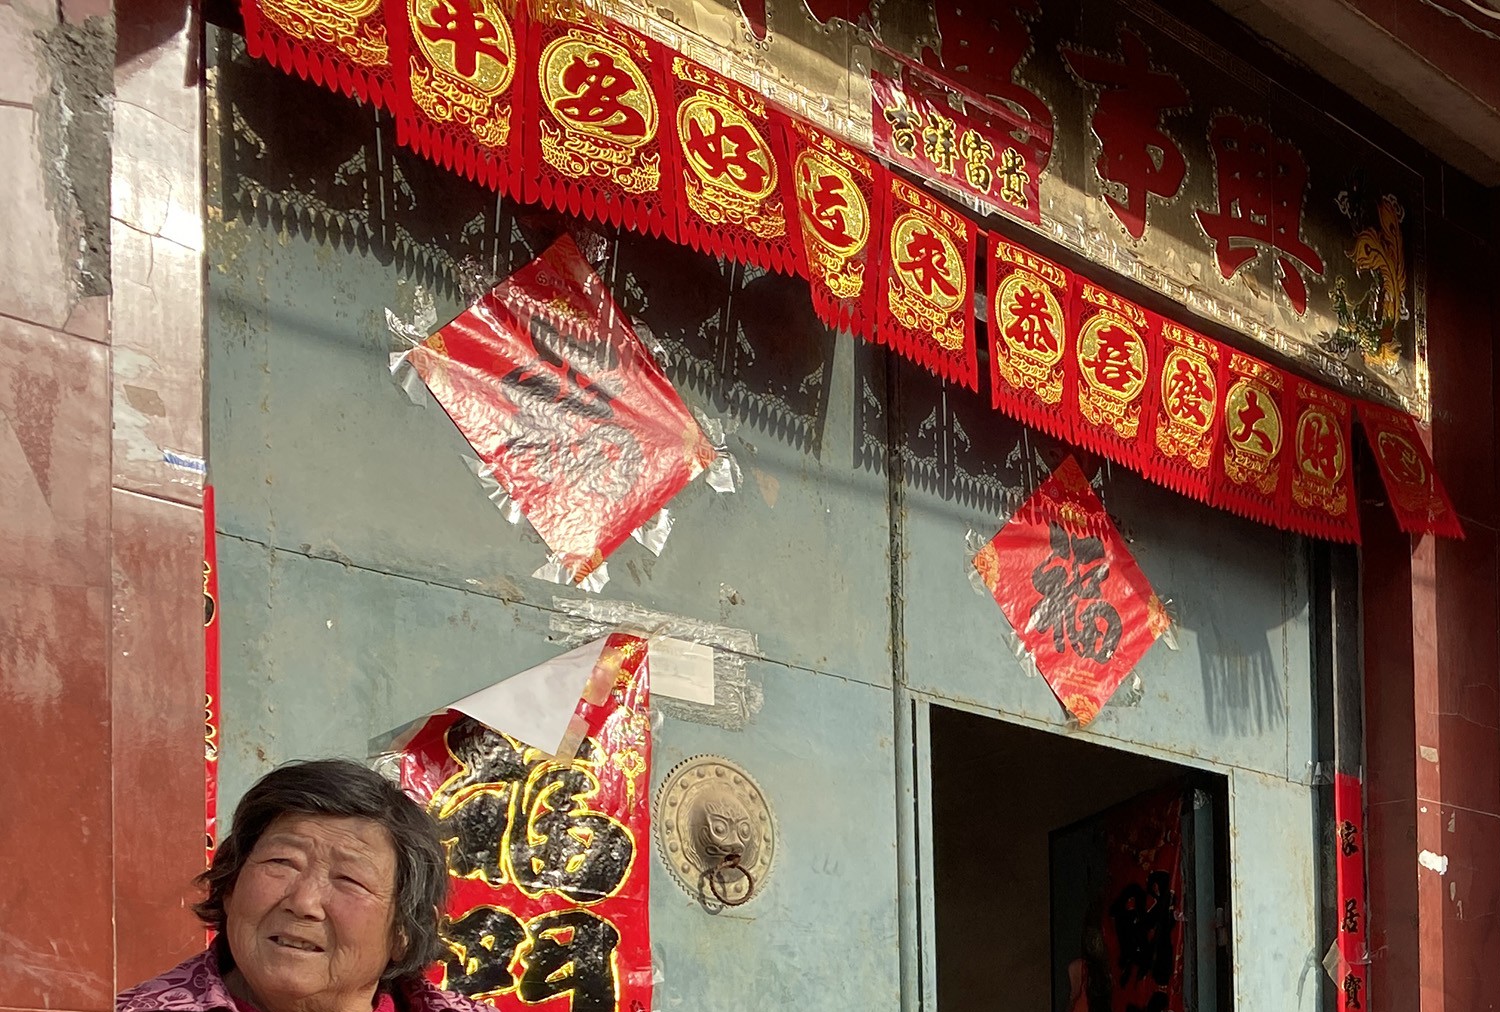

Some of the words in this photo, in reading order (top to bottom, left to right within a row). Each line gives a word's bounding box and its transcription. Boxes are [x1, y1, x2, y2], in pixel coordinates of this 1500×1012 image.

[883, 103, 1030, 211] 吉祥富貴
[1027, 520, 1123, 664] 福
